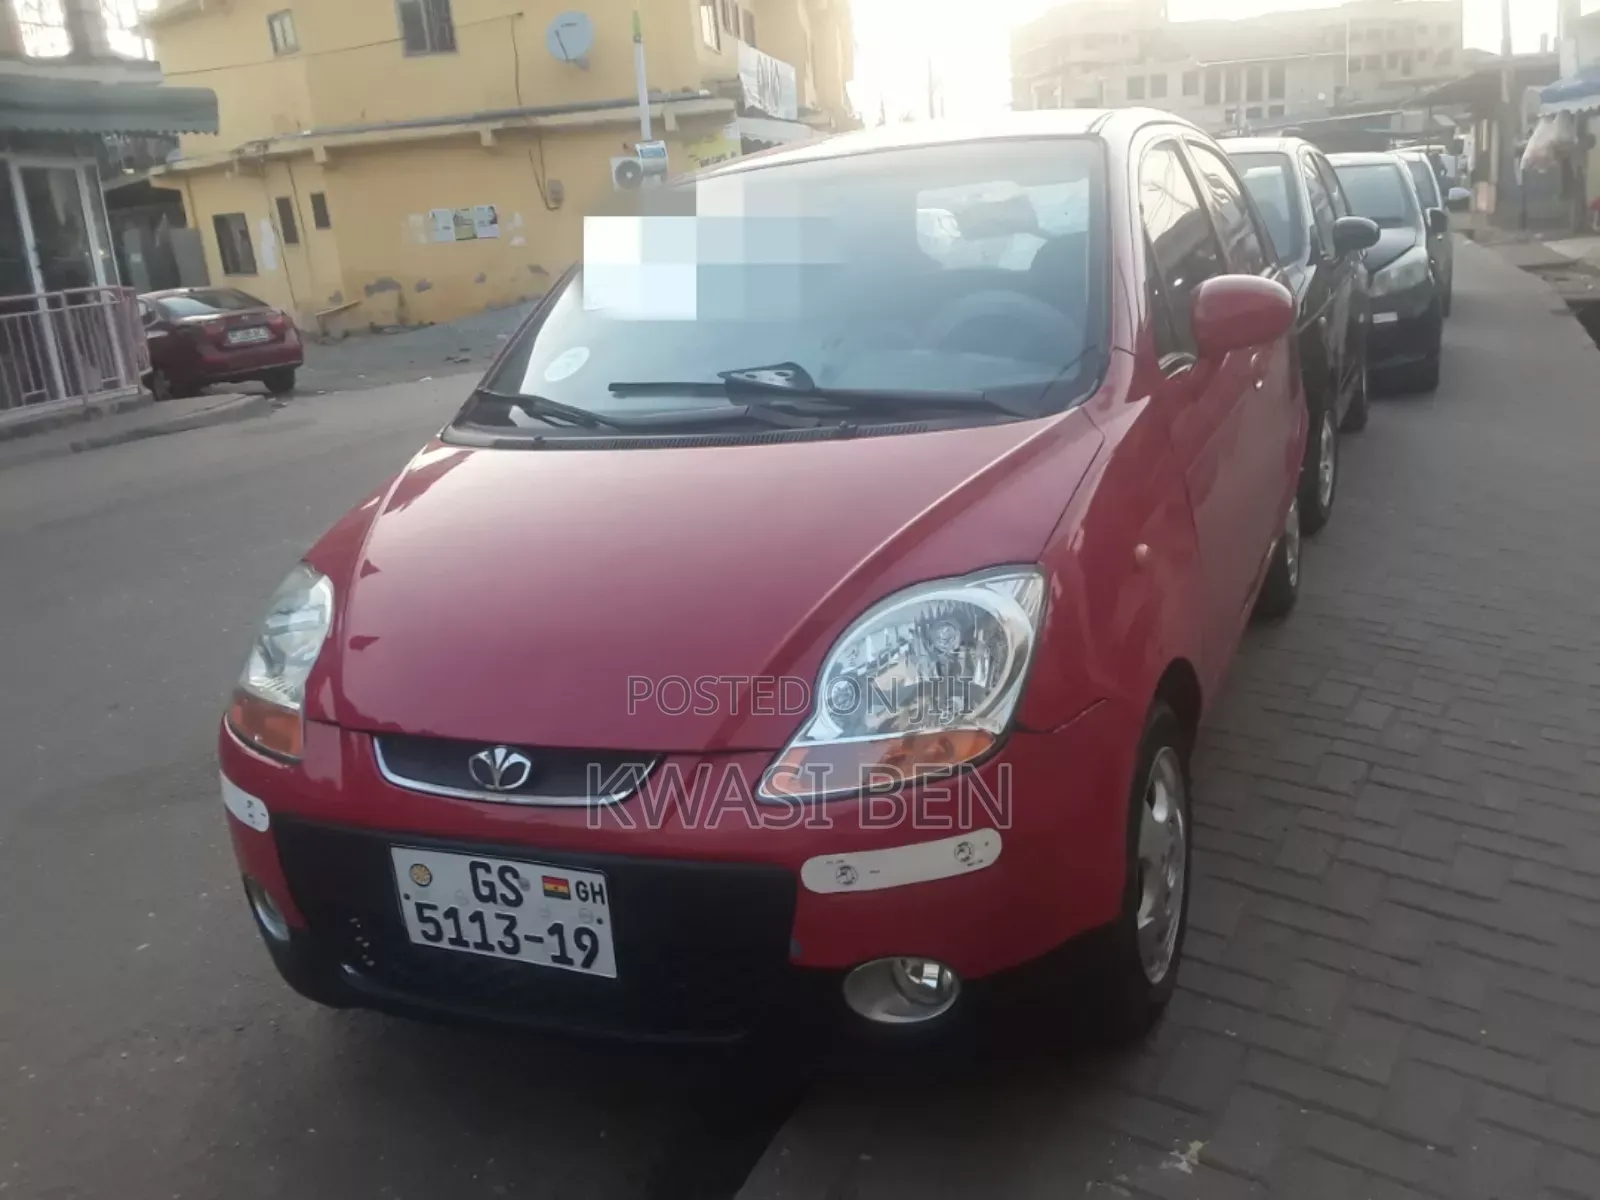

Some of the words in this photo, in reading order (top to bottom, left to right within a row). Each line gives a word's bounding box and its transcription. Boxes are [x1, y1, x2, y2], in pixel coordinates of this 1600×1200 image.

[469, 860, 524, 908] GS
[575, 880, 606, 905] GH
[414, 901, 600, 969] 5113-19
